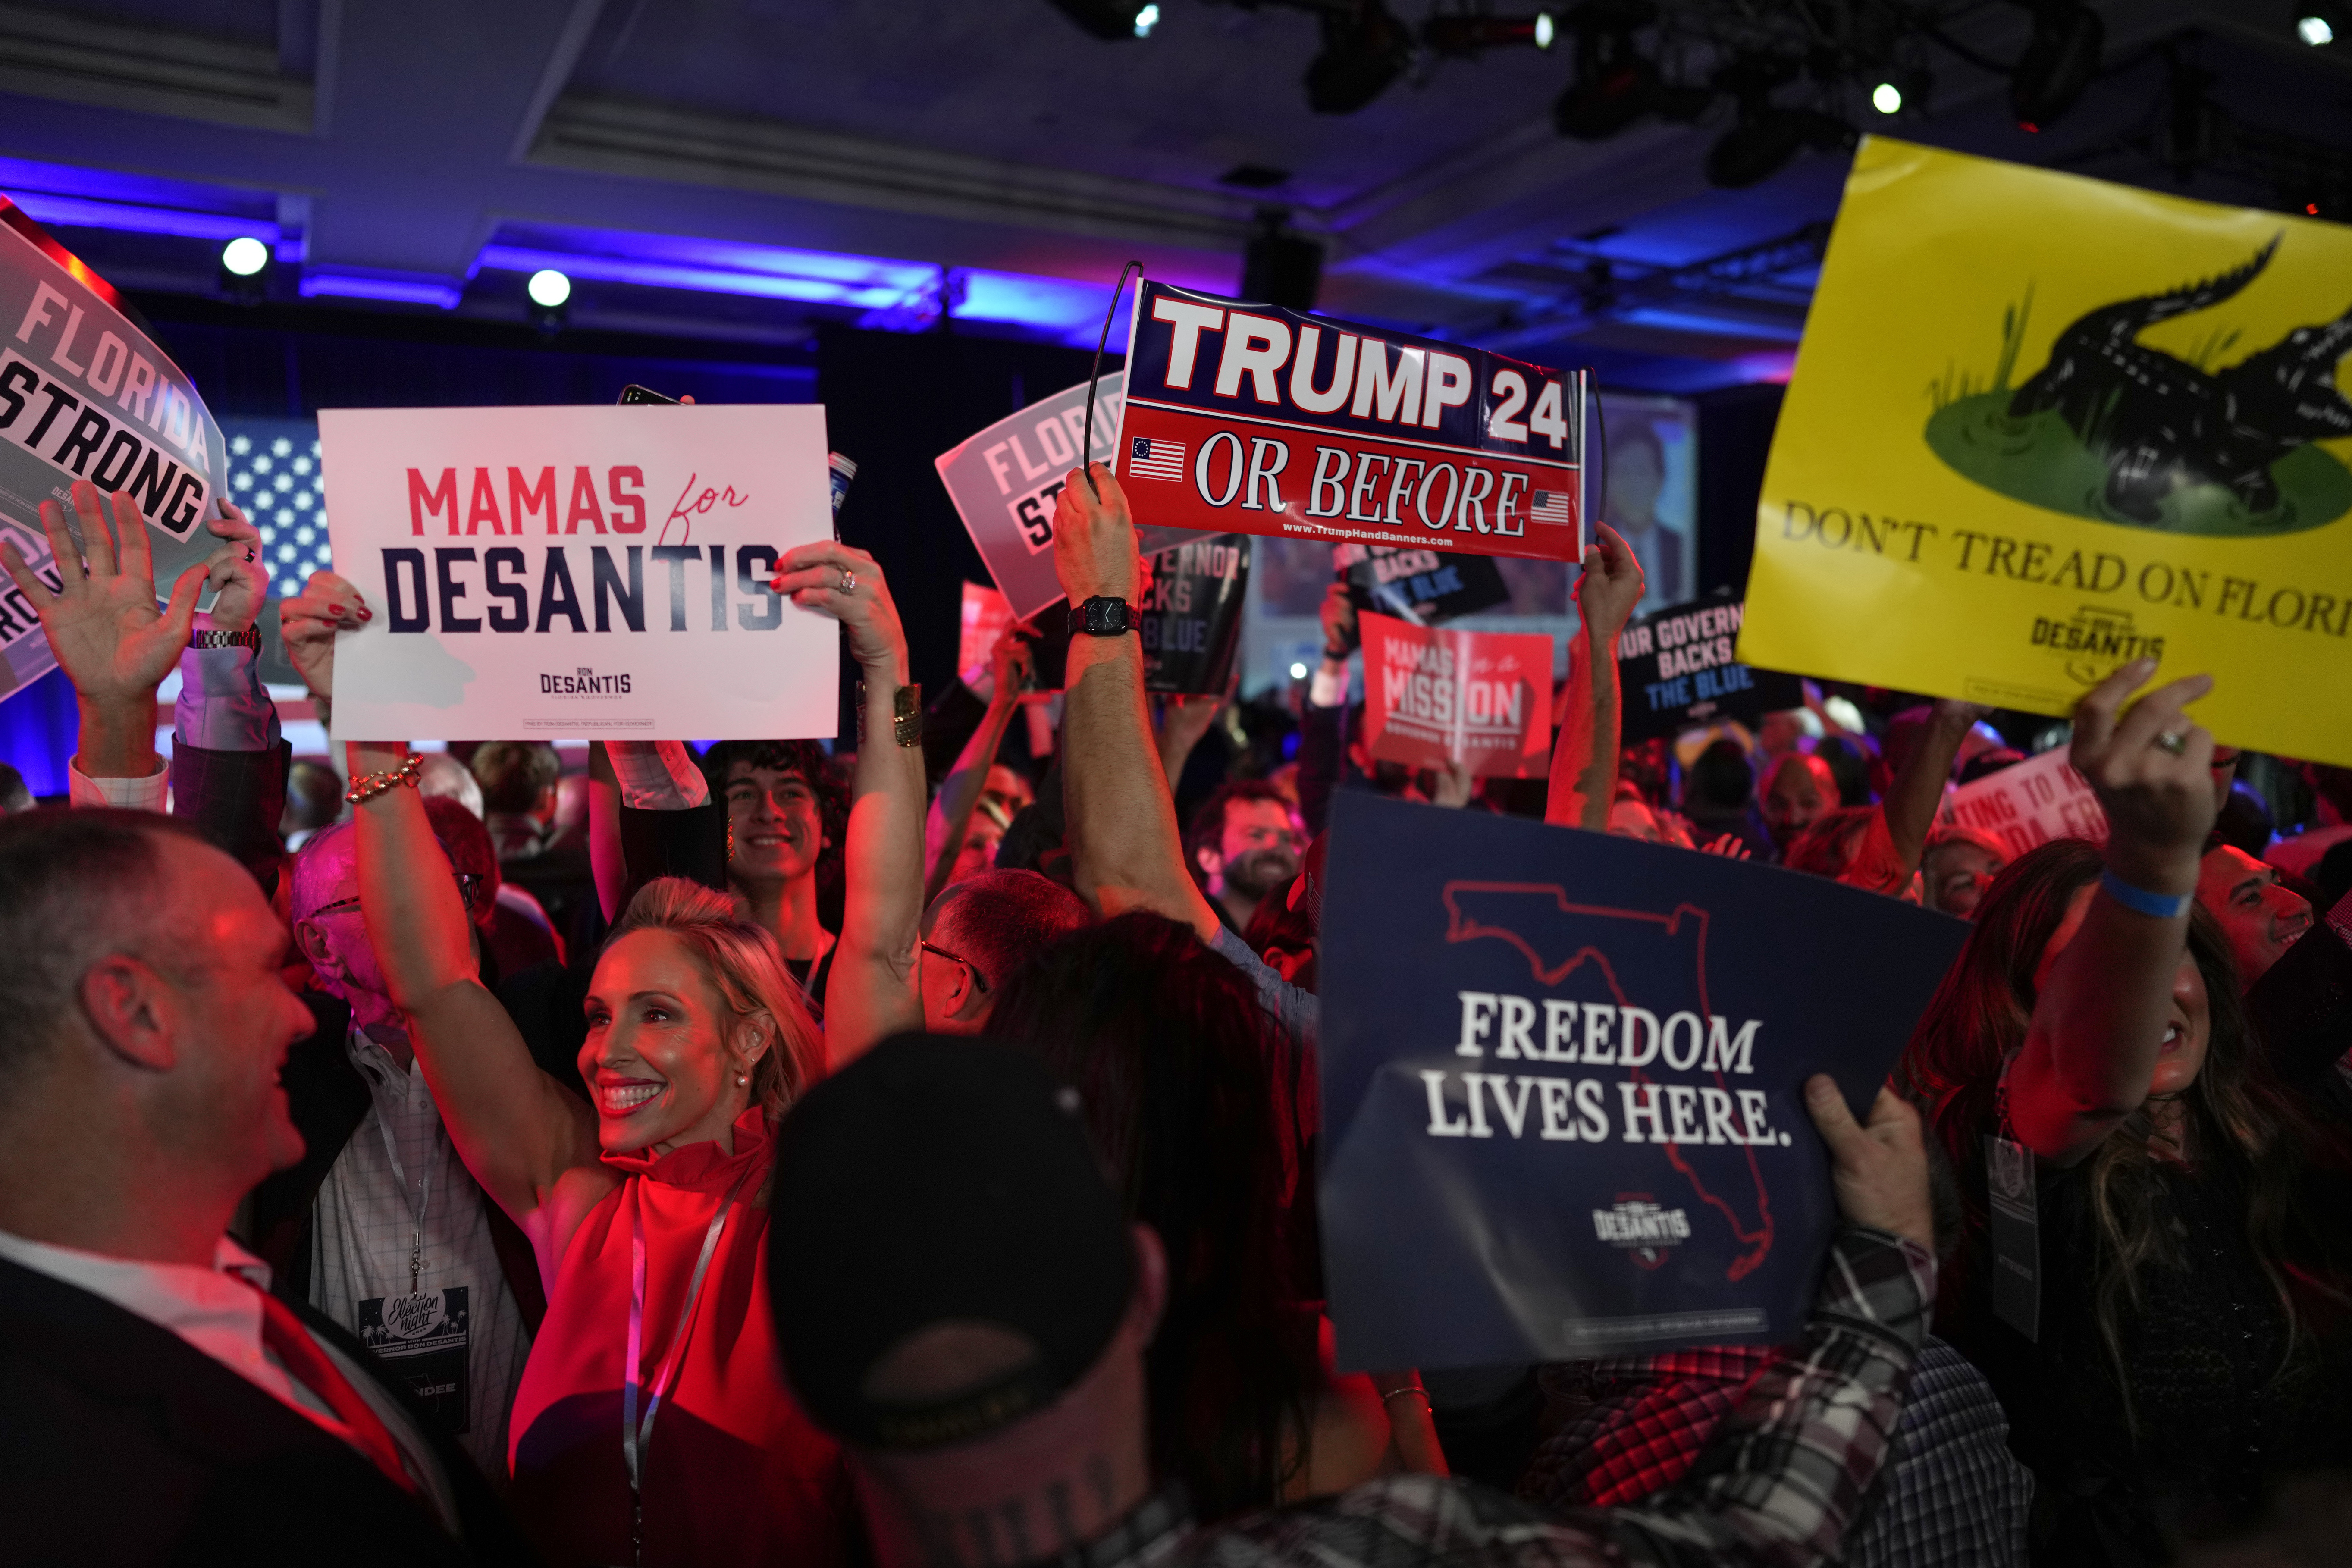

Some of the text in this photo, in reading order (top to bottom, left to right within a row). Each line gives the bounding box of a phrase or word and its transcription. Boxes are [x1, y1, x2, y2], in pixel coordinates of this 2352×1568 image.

[16, 279, 211, 473] FLORIDA
[1151, 294, 1568, 451] TRUMP 24
[0, 361, 206, 534] STRONG
[407, 466, 749, 550] MAMAS for
[1194, 430, 1529, 537] OR BEFORE
[1283, 523, 1453, 546] www.TrumpHandBanners.com
[380, 544, 784, 633] DESANTIS
[1782, 499, 2352, 637] DON'T TREAD ON FLORI
[1656, 602, 1744, 650] GOVERN
[2032, 617, 2165, 662] DESANTIS
[540, 674, 632, 693] DESANTIS
[1658, 636, 1733, 681] BACKS
[1383, 665, 1523, 726] MISSION
[1645, 675, 1692, 711] THE
[1456, 990, 1763, 1074] FREEDOM
[1420, 1070, 1791, 1148] LIVES HERE.
[388, 1293, 439, 1325] Election
[400, 1311, 437, 1331] night
[373, 1345, 406, 1354] VERNOR
[426, 1336, 466, 1347] DESANTIS
